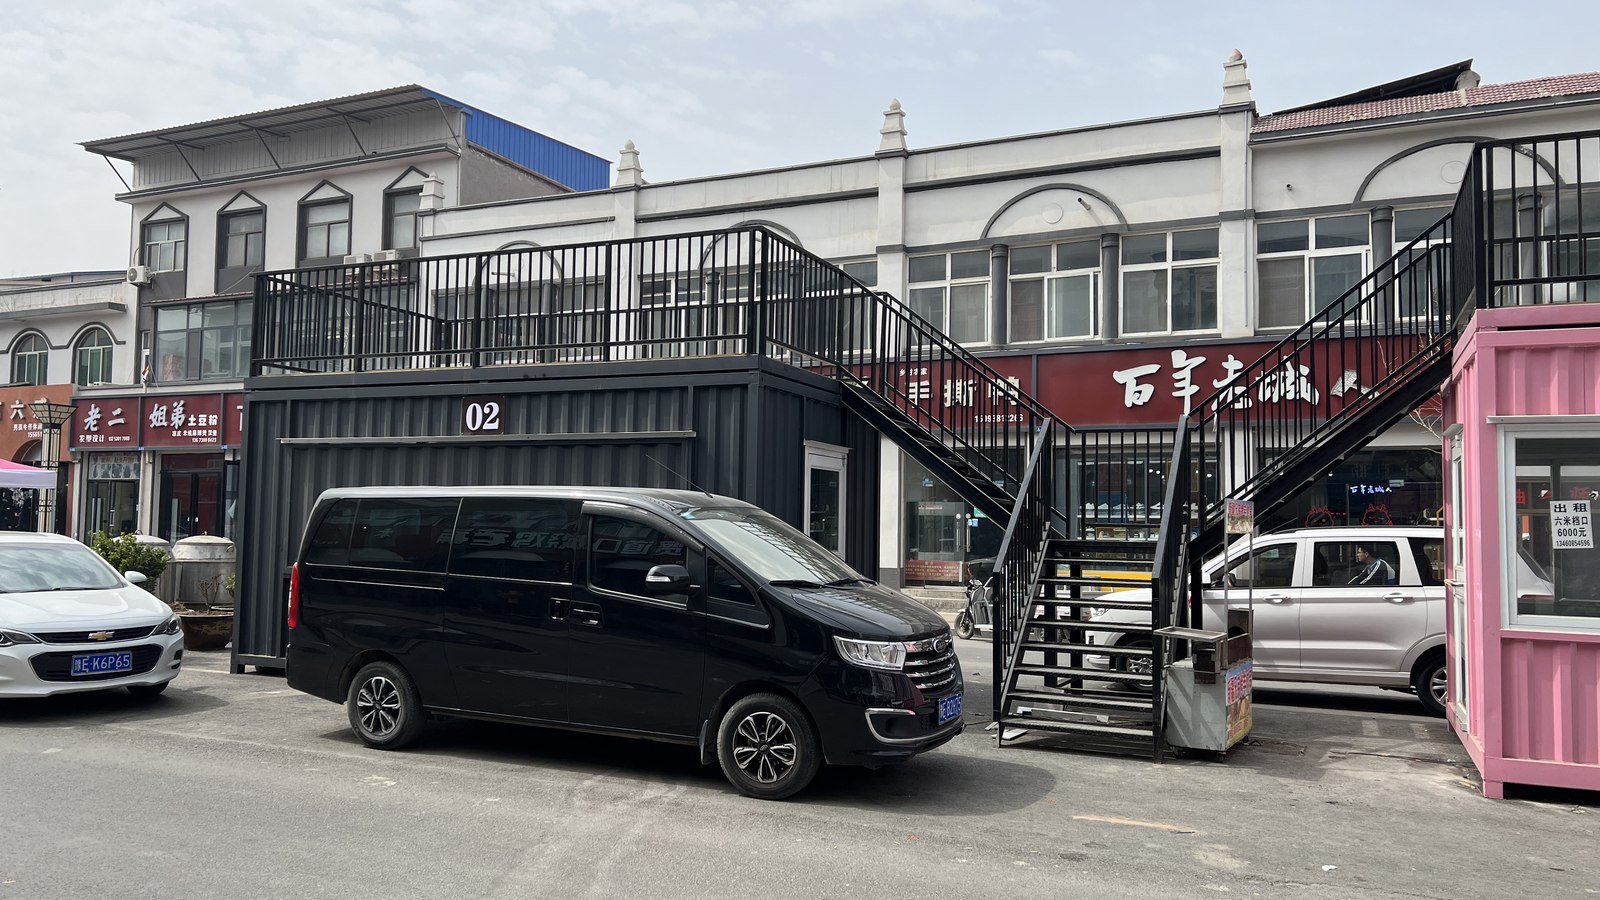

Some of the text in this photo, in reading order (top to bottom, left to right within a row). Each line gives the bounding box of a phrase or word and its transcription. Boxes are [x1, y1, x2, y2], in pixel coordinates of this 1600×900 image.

[83, 403, 125, 431] 老二
[149, 400, 186, 429] 姐弟
[188, 414, 218, 426] 土豆粉
[466, 402, 500, 430] 02
[1554, 503, 1587, 513] 出租
[1554, 516, 1588, 526] 六米档口
[1557, 528, 1587, 537] 6000元
